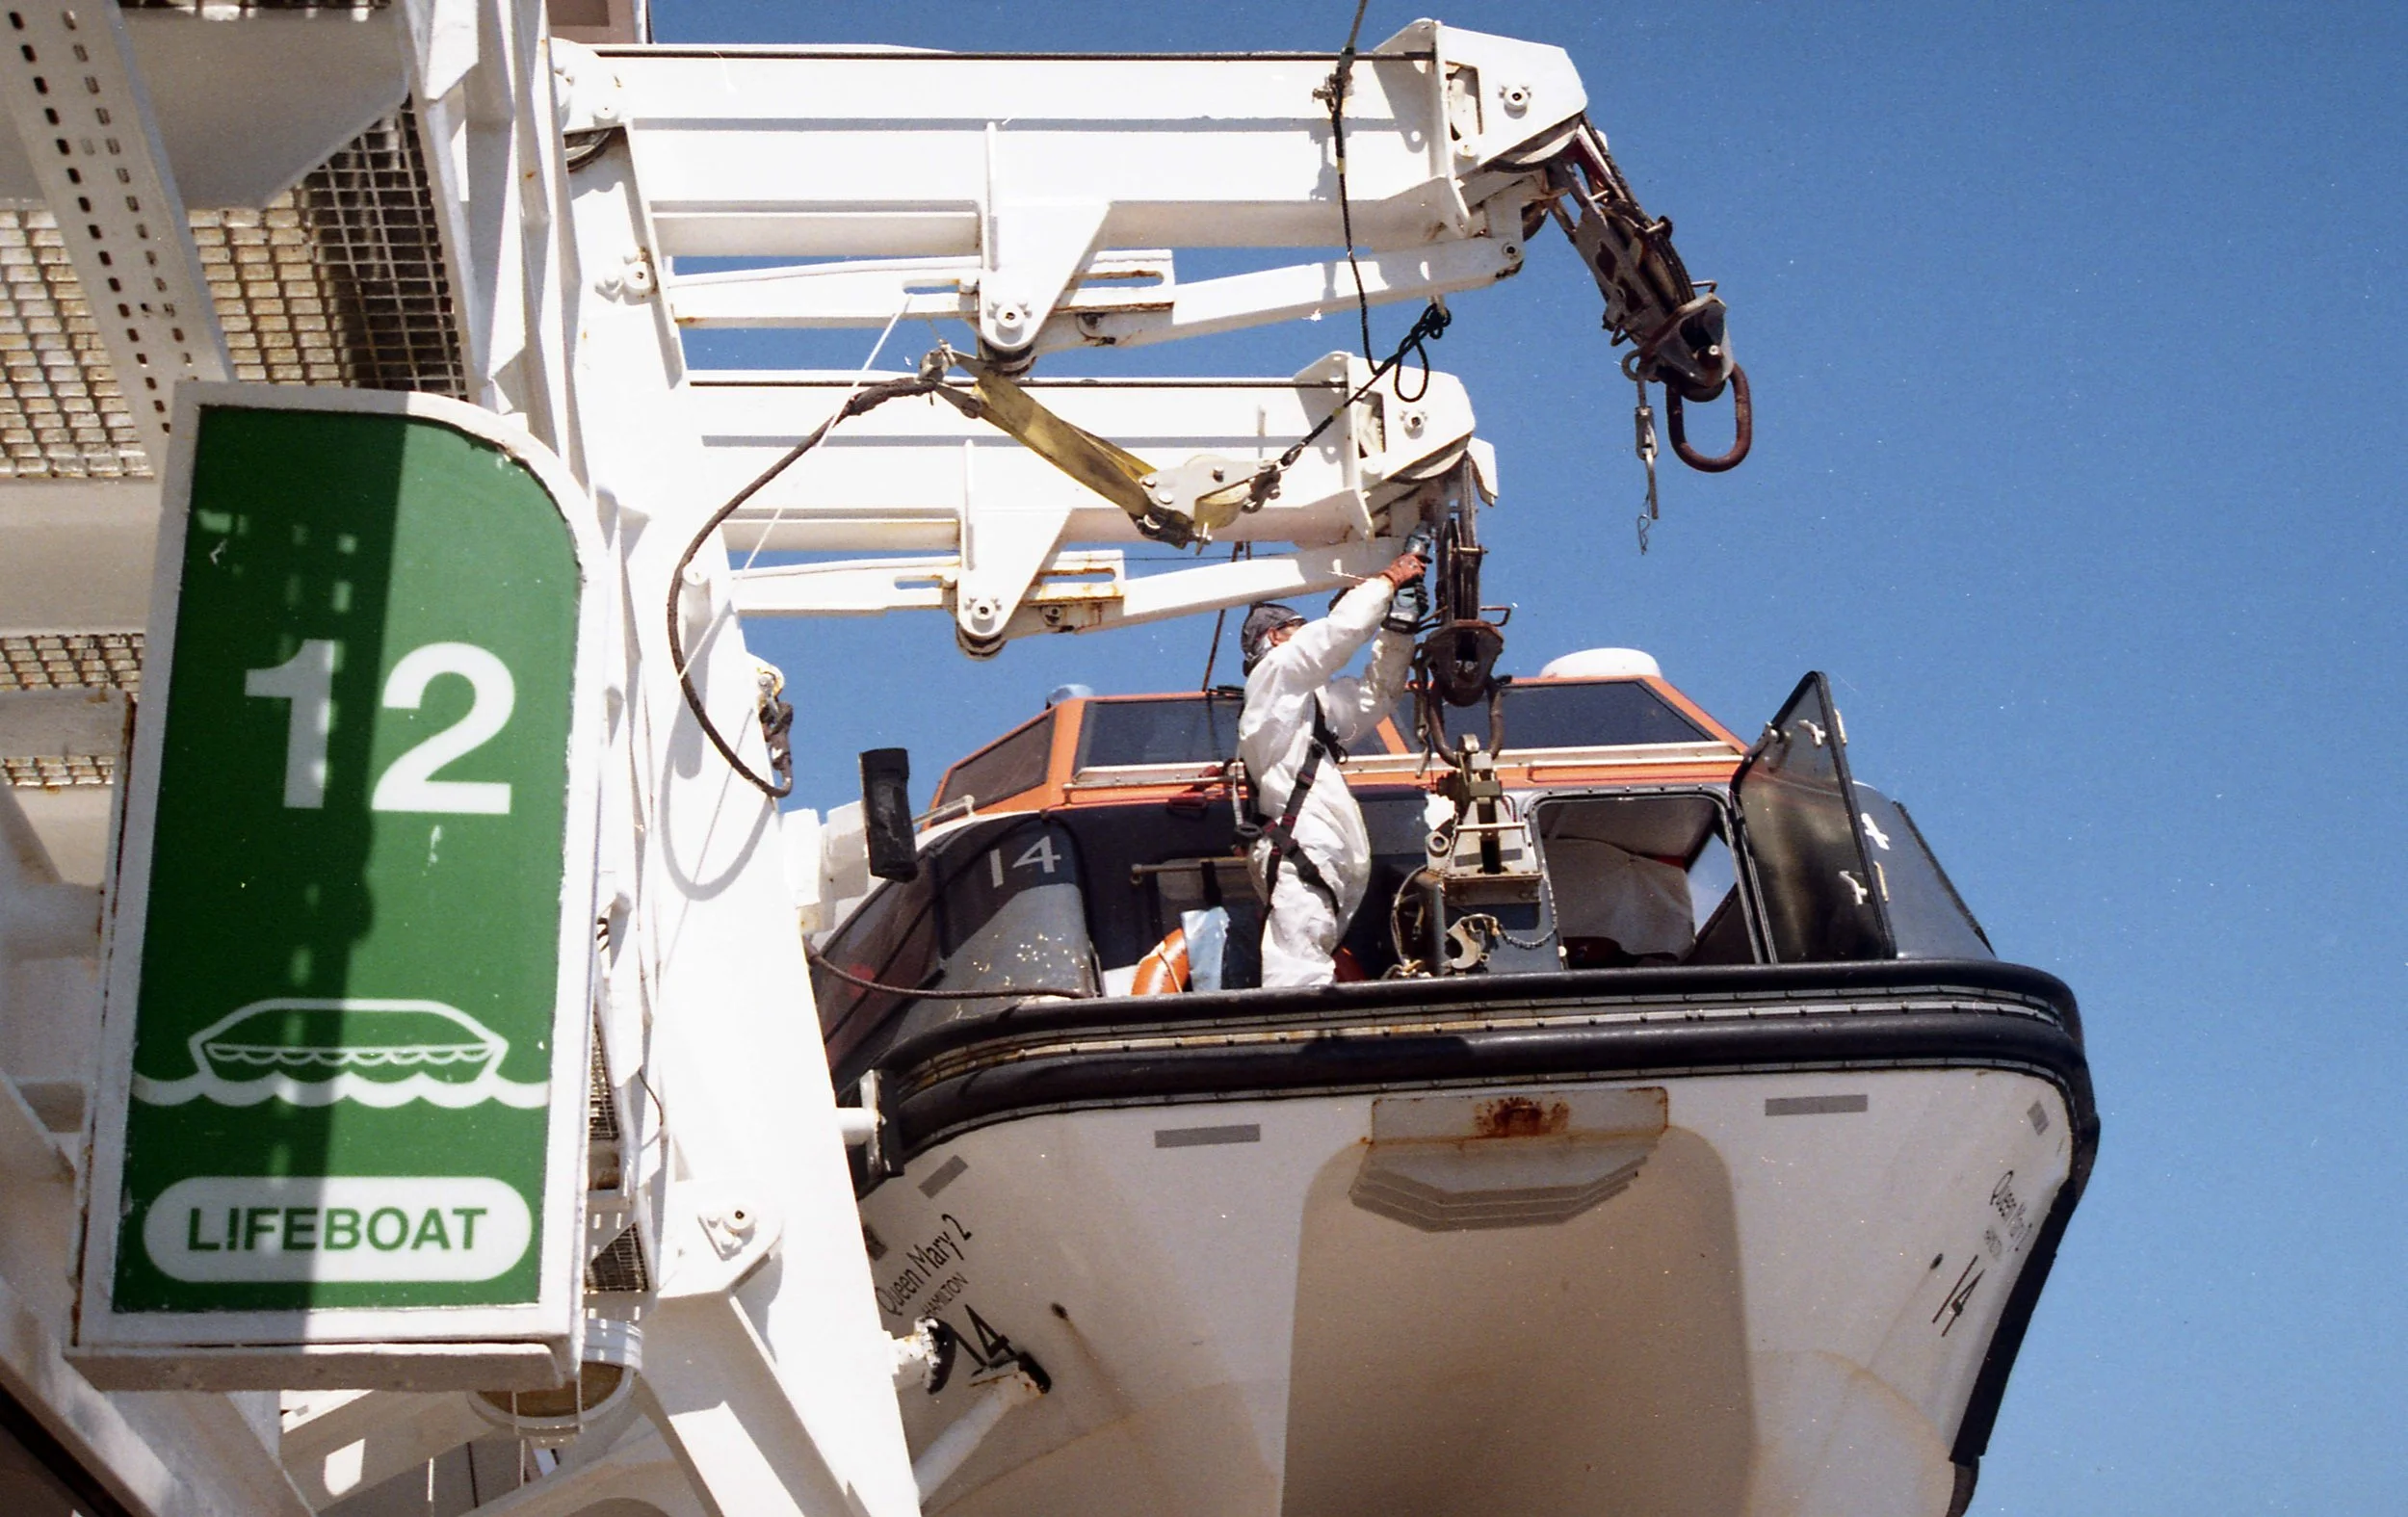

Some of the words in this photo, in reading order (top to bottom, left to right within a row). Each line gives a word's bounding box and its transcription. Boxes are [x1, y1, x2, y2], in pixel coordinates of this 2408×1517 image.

[244, 639, 515, 815] 12
[989, 835, 1061, 888] 14
[187, 1206, 488, 1251] LIFEBOAT
[876, 1269, 925, 1317] Queen
[906, 1232, 964, 1277] Mary
[942, 1214, 972, 1241] 2
[1932, 1254, 1985, 1337] 14
[954, 1304, 1016, 1368] 14
